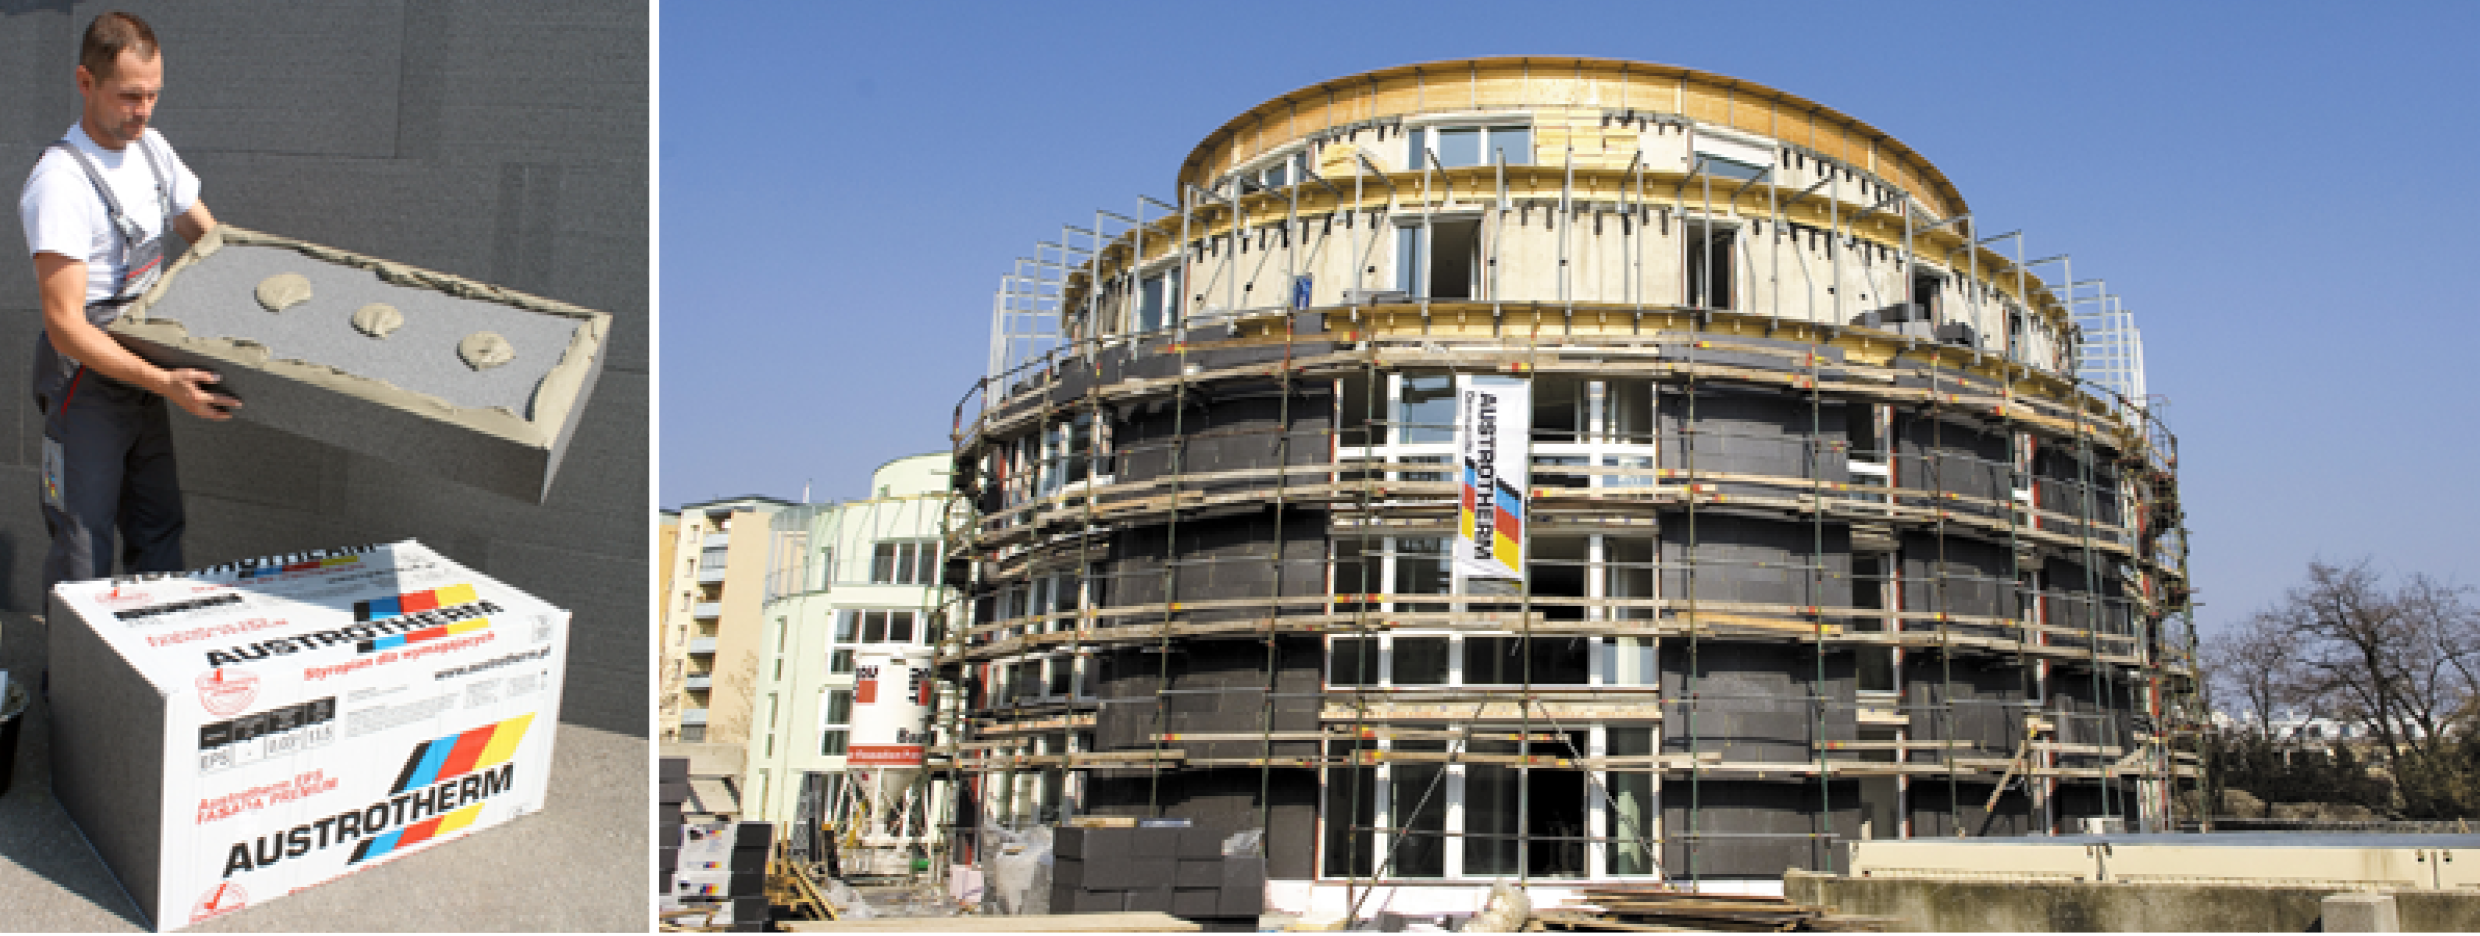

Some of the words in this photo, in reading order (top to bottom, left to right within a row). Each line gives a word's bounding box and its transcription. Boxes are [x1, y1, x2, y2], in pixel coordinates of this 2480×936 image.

[1473, 392, 1498, 560] AUSTROTHERM
[206, 599, 505, 668] AUSTROTHERM
[199, 779, 293, 808] Austrotherm
[222, 761, 514, 878] AUSTROTHERM
